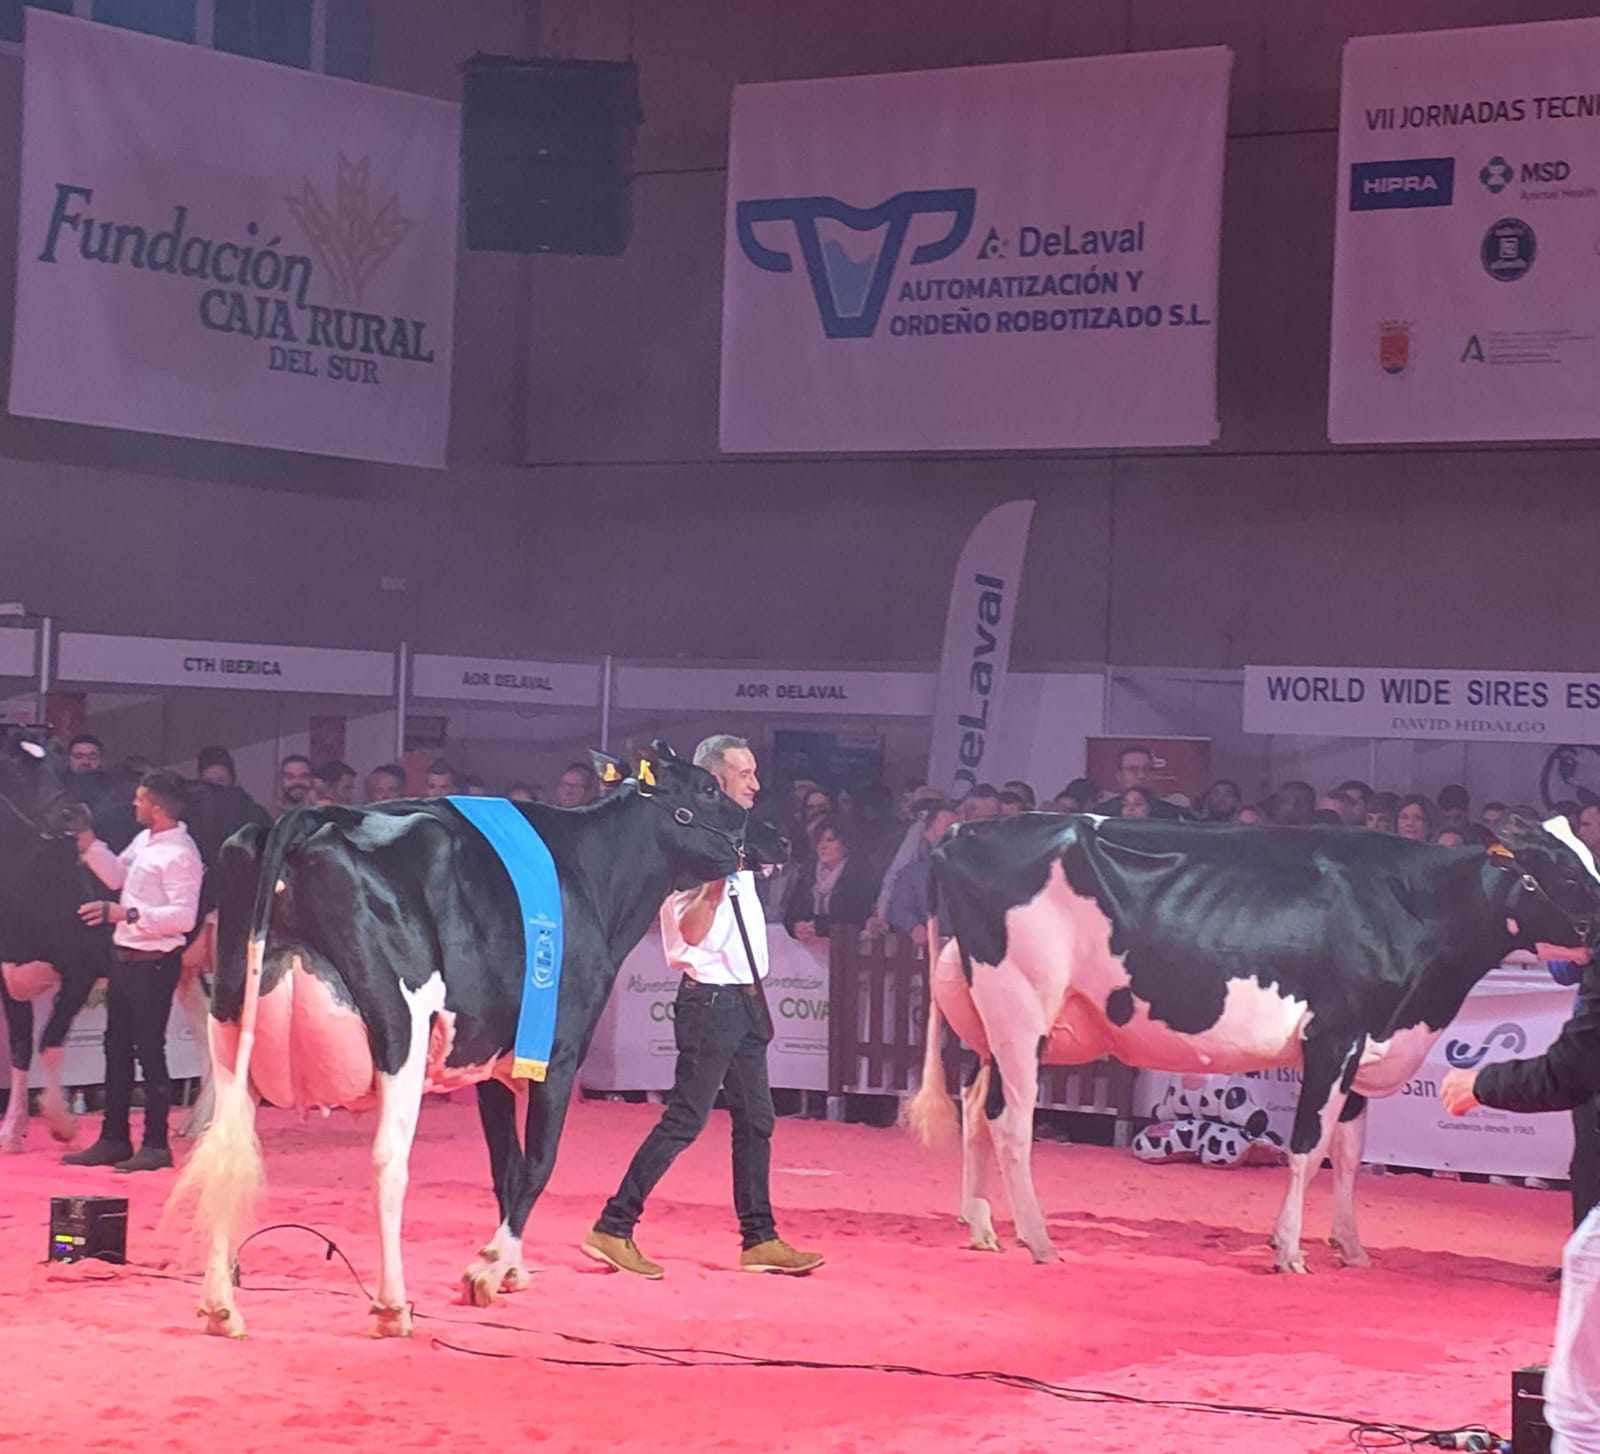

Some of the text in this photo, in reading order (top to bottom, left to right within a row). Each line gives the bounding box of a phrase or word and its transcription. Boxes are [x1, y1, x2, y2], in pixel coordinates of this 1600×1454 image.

[1365, 107, 1394, 130] VII
[1399, 99, 1526, 129] JORNADAS
[1363, 175, 1439, 194] HIPRA
[1520, 161, 1571, 183] MSD
[38, 182, 314, 310] Fundación
[1018, 221, 1145, 258] DeLaval
[898, 265, 1144, 302] AUTOMATIZACIÓN Y
[200, 288, 435, 363] CAJA RURAL
[889, 306, 991, 337] ORDEÑO
[995, 304, 1163, 334] ROBOTIZADO
[268, 346, 381, 385] DEL SUR
[183, 656, 282, 677] CTH IBERICA
[462, 671, 553, 691] AOR DELAVAL
[735, 683, 849, 700] AOR DELAVAL
[1267, 675, 1365, 703] WORLD
[1381, 677, 1451, 705] WIDE
[1467, 679, 1550, 709] SIRES
[1391, 716, 1546, 735] DAVID HIDALGO
